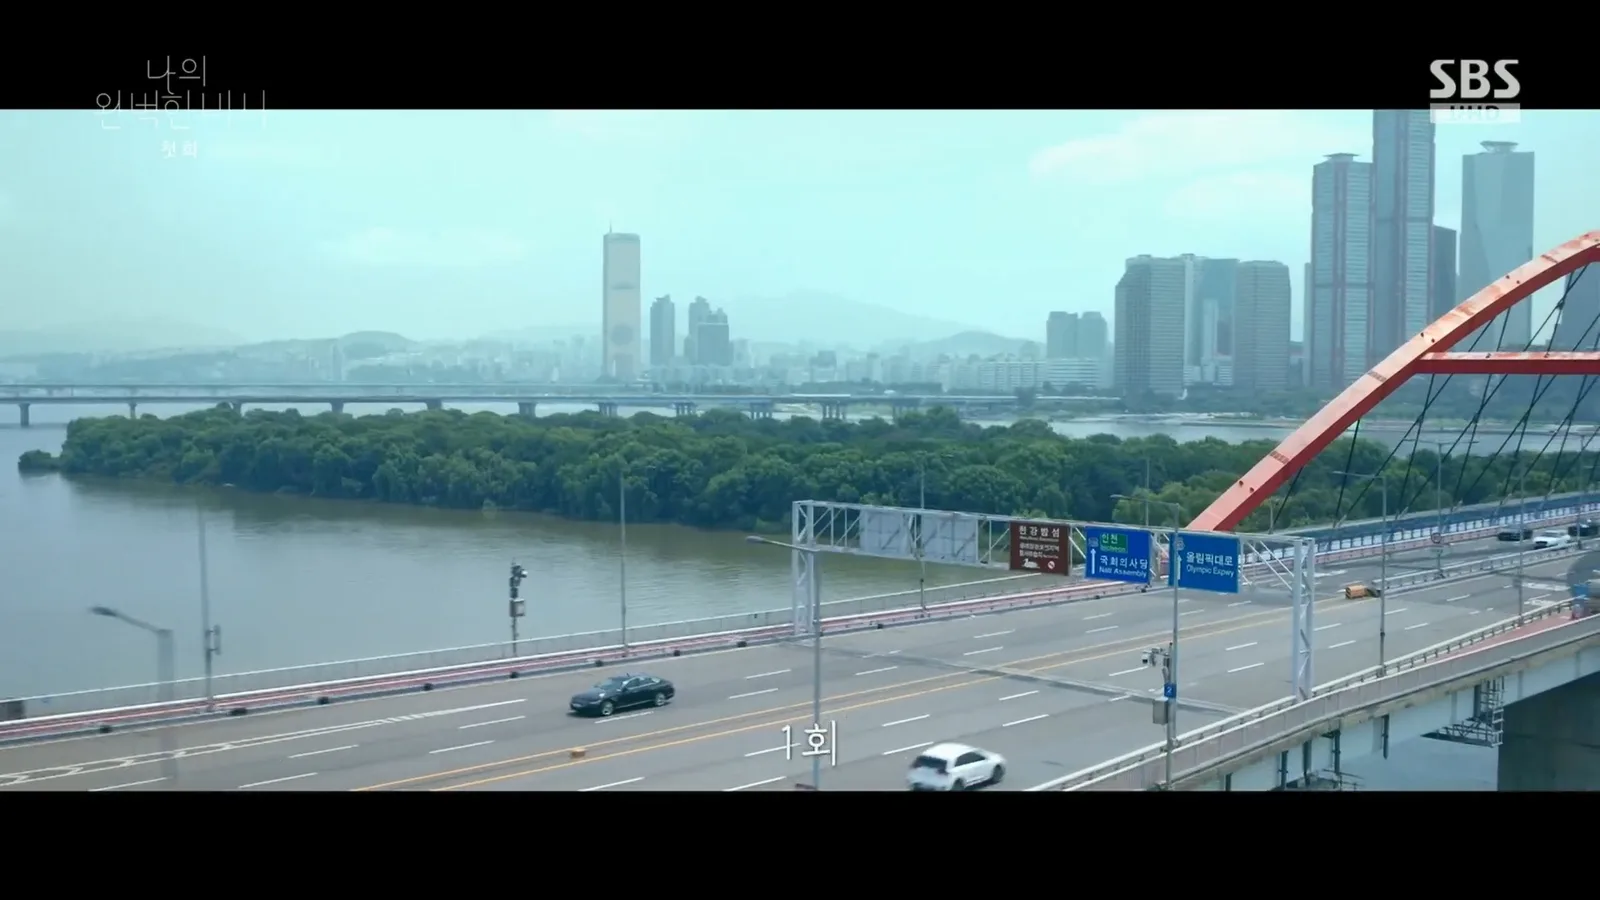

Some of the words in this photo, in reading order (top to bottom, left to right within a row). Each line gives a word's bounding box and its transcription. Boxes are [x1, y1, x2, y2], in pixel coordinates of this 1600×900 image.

[1100, 555, 1148, 570] 국회의사당
[1186, 551, 1234, 567] 올림픽대로
[1113, 568, 1147, 579] Assembly
[1186, 564, 1212, 575] Olympic
[1212, 566, 1235, 578] Expwy
